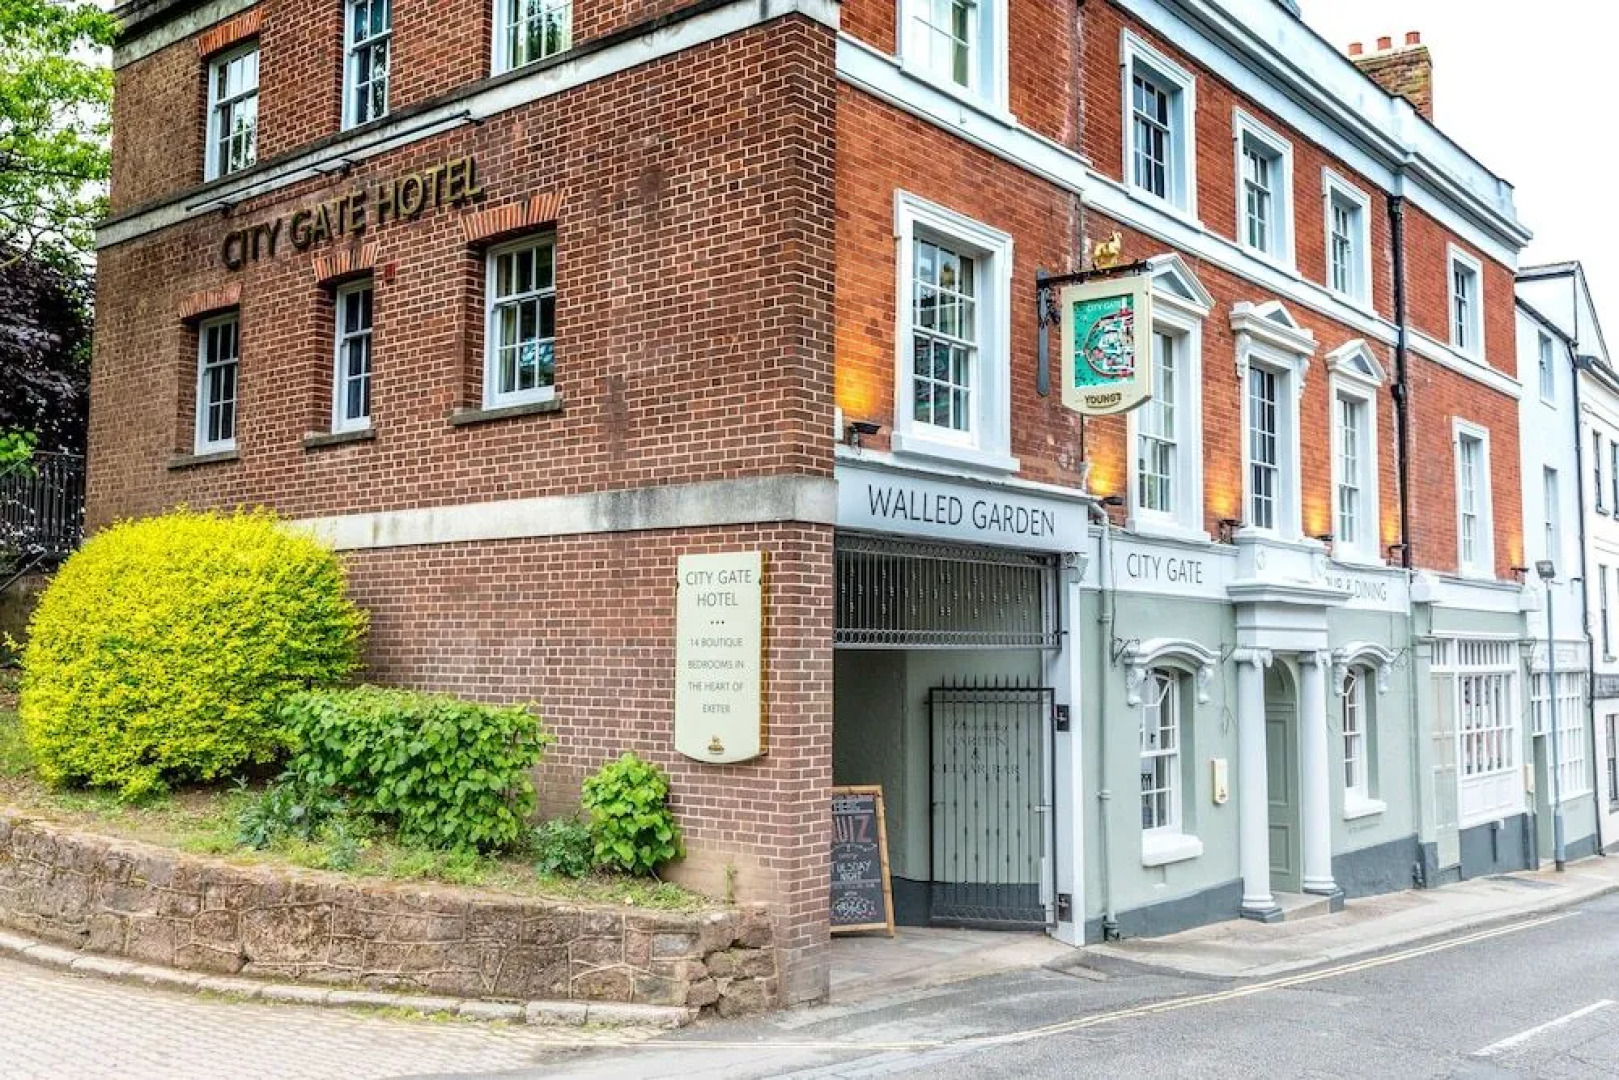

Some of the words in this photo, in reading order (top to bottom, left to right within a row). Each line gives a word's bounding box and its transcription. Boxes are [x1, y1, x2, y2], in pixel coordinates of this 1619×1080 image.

[222, 218, 281, 271] CITY
[290, 191, 367, 250] GATE
[376, 155, 484, 223] HOTEL
[868, 484, 963, 525] WALLED
[972, 500, 1055, 537] GARDEN
[1126, 553, 1161, 580] CITY
[1166, 558, 1203, 584] GATE
[686, 571, 714, 585] CITY
[718, 569, 752, 584] GATE
[1354, 580, 1386, 601] DINING
[697, 592, 738, 607] HOTEL
[690, 637, 699, 647] 14
[701, 637, 743, 648] BOUTIQUE
[688, 660, 732, 669] BEDROOMS
[735, 660, 744, 668] IN
[688, 682, 701, 691] THE
[704, 682, 730, 691] HEART
[732, 682, 744, 691] OF
[702, 704, 730, 713] EXETER
